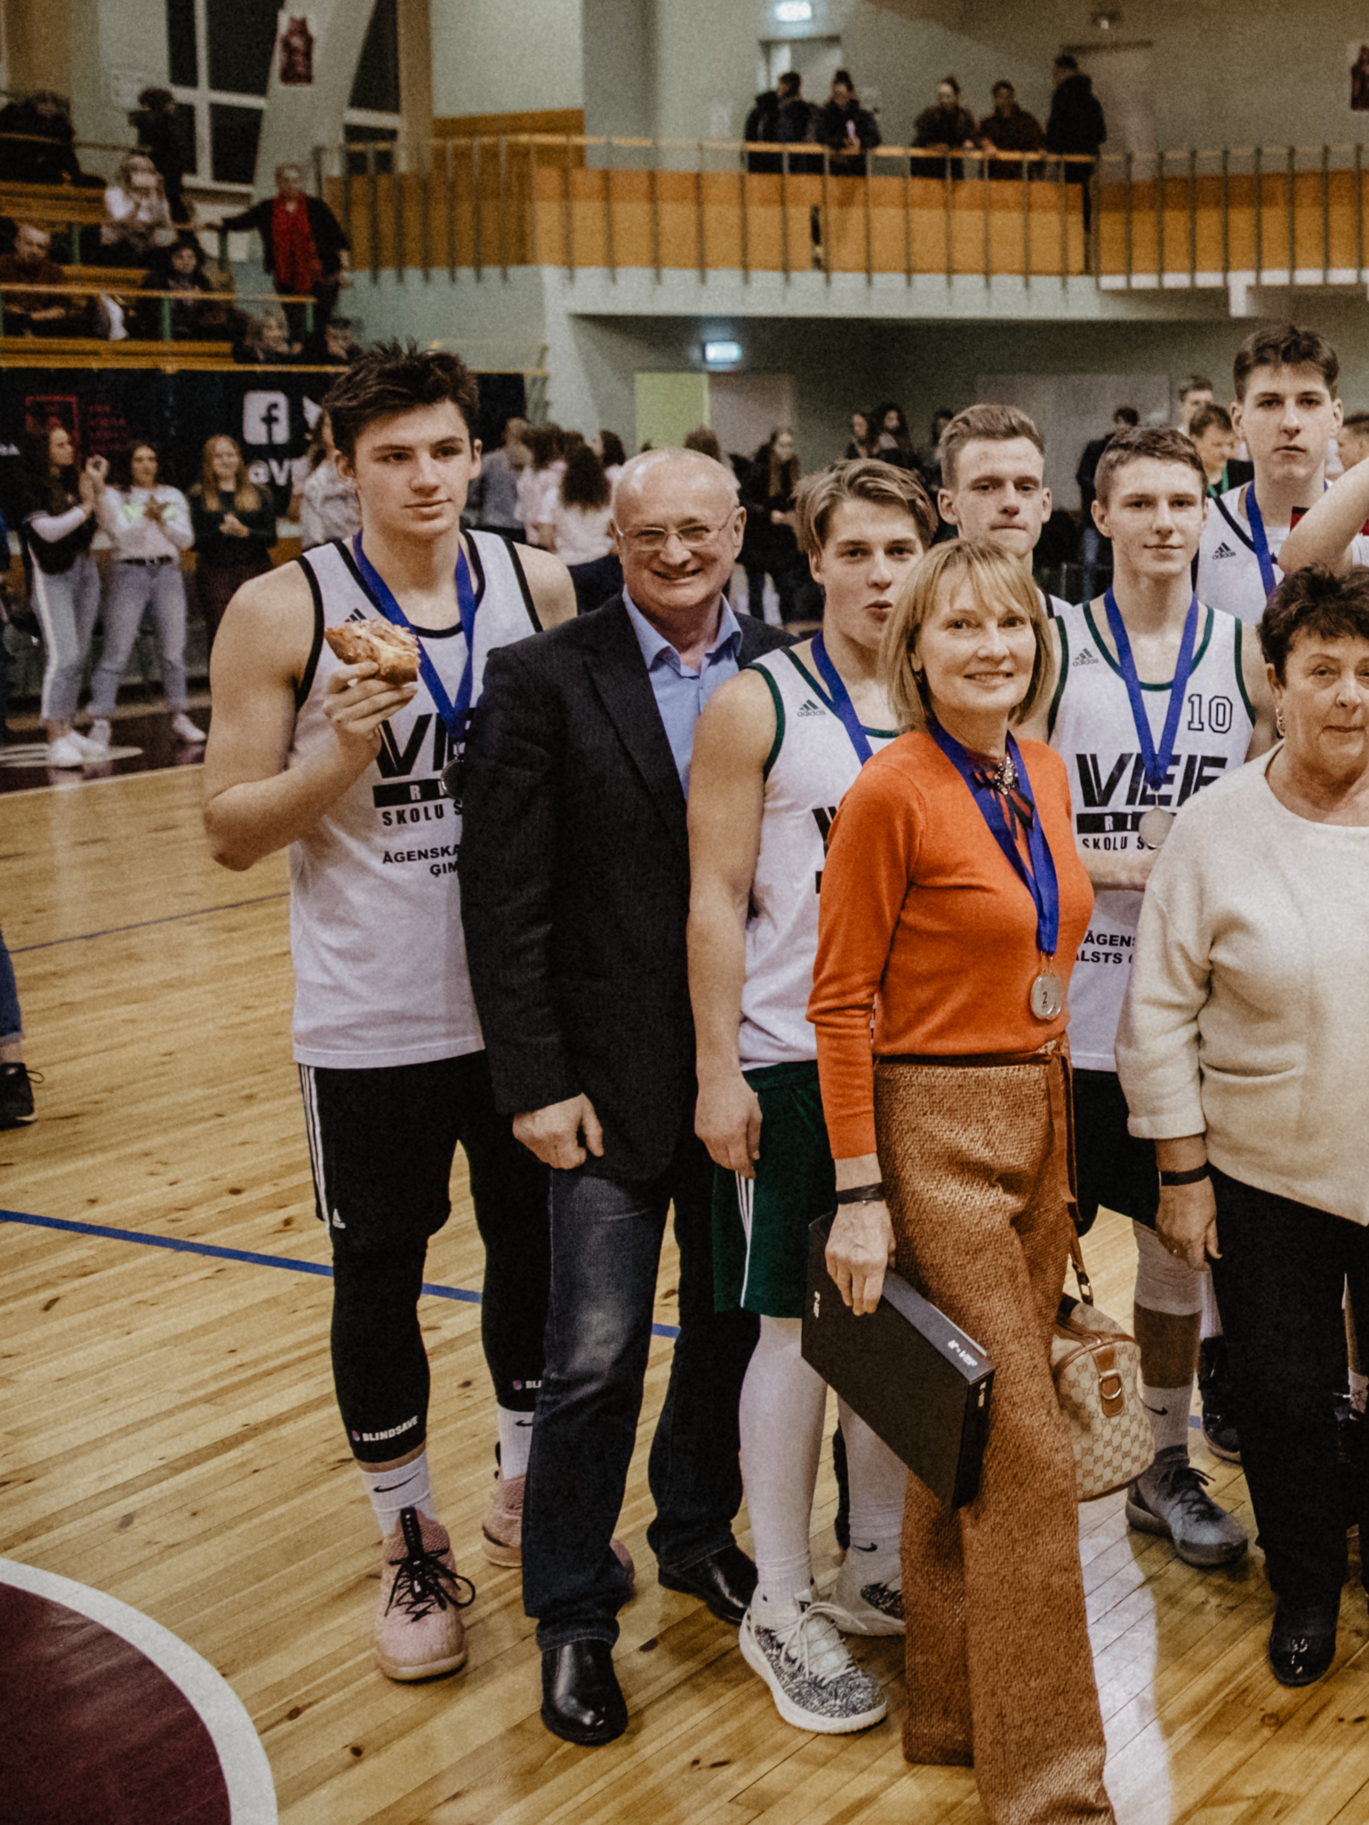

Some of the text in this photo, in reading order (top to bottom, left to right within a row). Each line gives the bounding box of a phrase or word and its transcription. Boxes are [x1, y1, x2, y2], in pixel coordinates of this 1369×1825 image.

[1187, 694, 1233, 734] 10
[382, 804, 444, 826] SKOLU
[1082, 836, 1128, 851] SKOLU
[362, 1415, 418, 1442] BLINDSAVE
